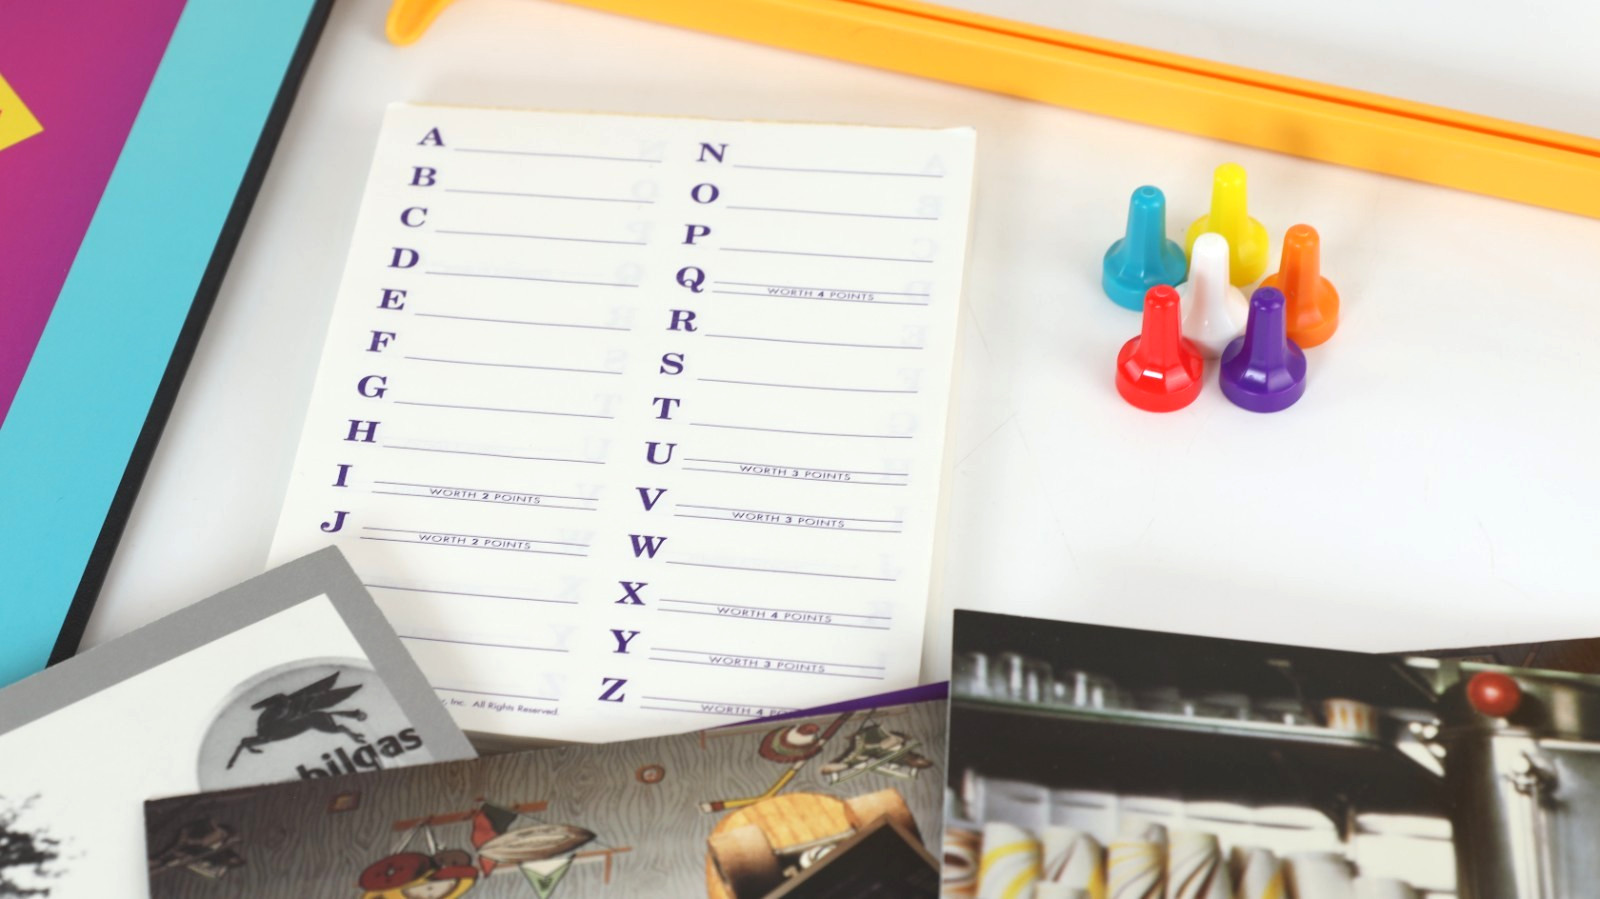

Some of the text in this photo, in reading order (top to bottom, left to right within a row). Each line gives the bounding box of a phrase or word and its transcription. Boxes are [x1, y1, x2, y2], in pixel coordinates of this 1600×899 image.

[417, 126, 446, 147] A
[696, 143, 728, 163] N
[408, 166, 437, 187] B
[690, 183, 719, 204] O
[400, 207, 428, 228] C
[681, 224, 711, 245] P
[388, 247, 419, 268] D
[676, 266, 705, 293] Q
[377, 289, 407, 310] E
[767, 287, 813, 297] WORTH
[829, 291, 875, 301] POINTS
[666, 309, 698, 332] R
[366, 330, 396, 352] F
[659, 352, 684, 375] S
[357, 375, 388, 399] G
[652, 397, 680, 420] T
[344, 420, 381, 443] H
[645, 442, 677, 464] U
[332, 464, 353, 487] I
[740, 465, 852, 481] WORTH 3 POINTS
[429, 487, 541, 504] WORTH 2 POINTS
[636, 487, 668, 511] V
[320, 511, 350, 532] J
[732, 511, 779, 522] WORTH
[798, 518, 844, 528] POINTS
[419, 534, 532, 550] WORTH 2 POINTS
[628, 534, 667, 559] W
[615, 581, 648, 606] X
[716, 607, 832, 623] WORTH 4 POINTS
[609, 629, 640, 654] Y
[709, 656, 825, 673] WORTH 3 POINTS
[598, 678, 628, 702] Z
[472, 699, 486, 708] All
[488, 702, 514, 712] Rights
[701, 704, 750, 715] WORTH
